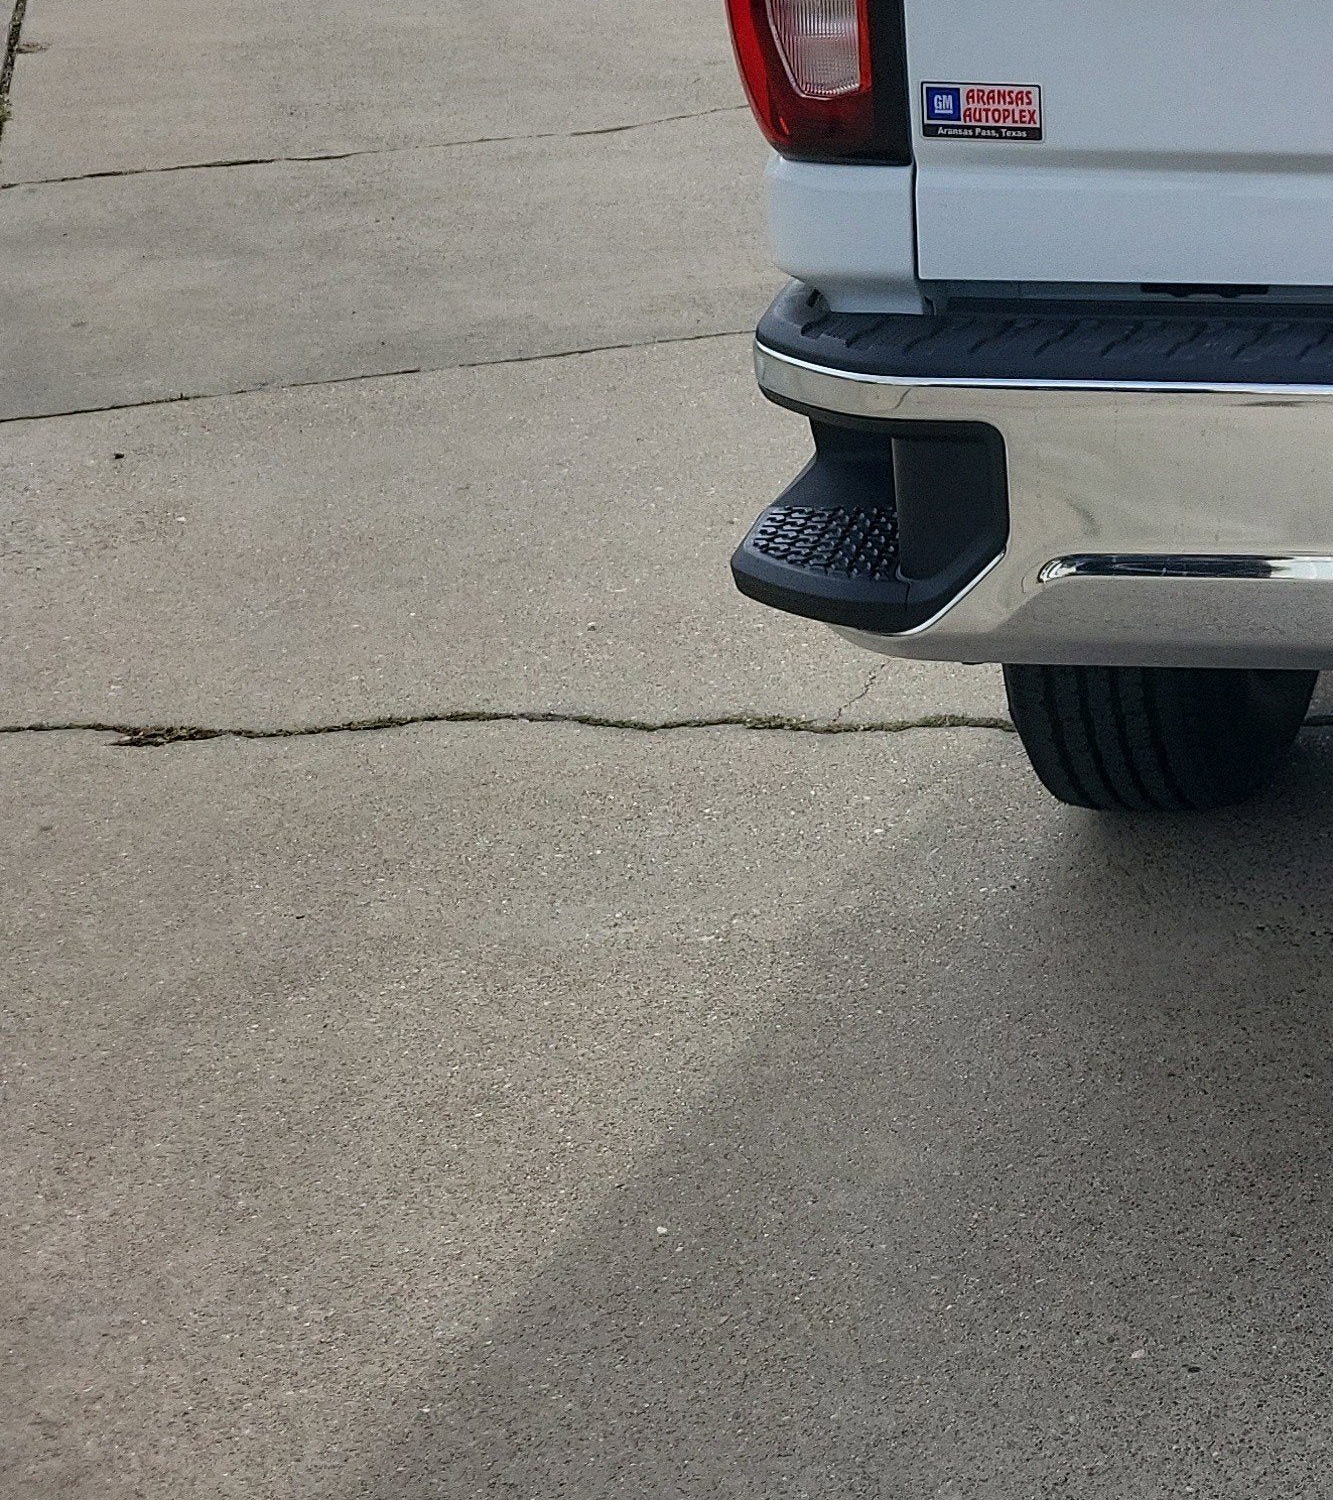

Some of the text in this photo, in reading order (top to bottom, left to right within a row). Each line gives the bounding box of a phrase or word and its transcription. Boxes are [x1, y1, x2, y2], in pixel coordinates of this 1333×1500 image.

[933, 94, 954, 113] GM
[965, 88, 1033, 107] ARANSAS
[962, 107, 1037, 125] AUTOPLEX
[937, 126, 1027, 138] Aransas Pass, Texas
